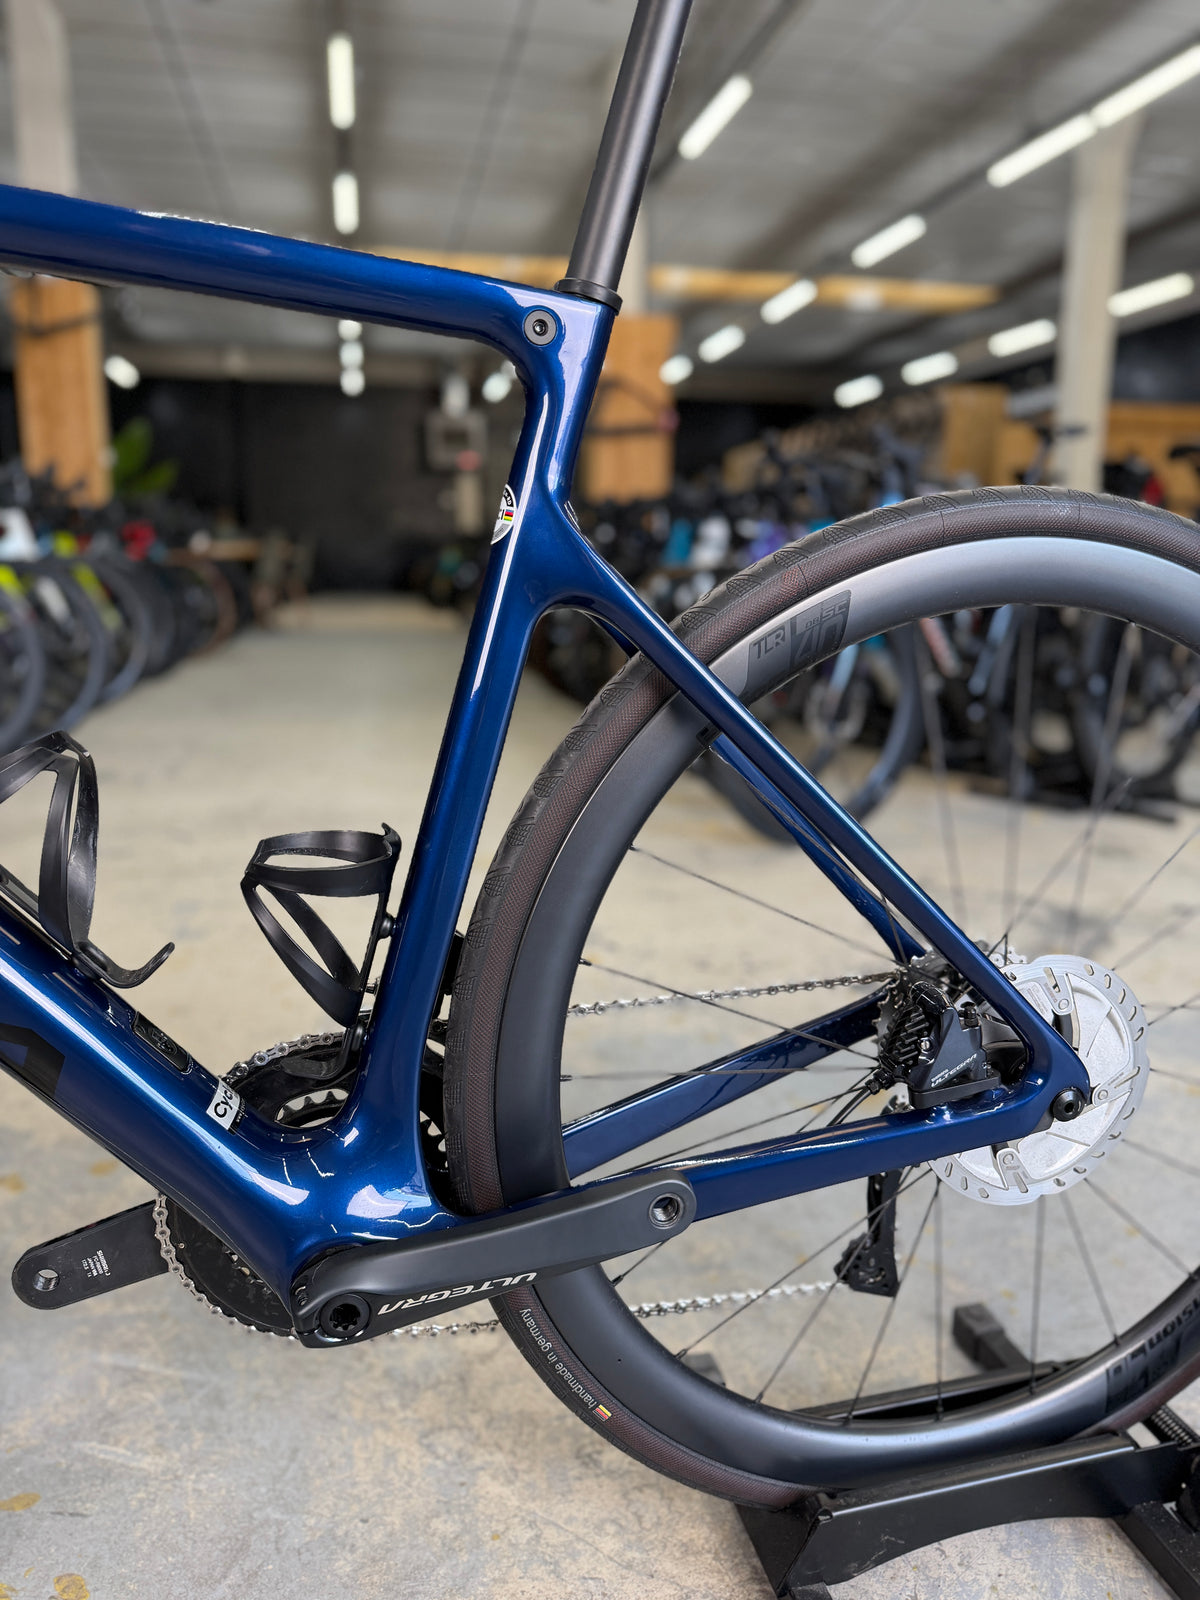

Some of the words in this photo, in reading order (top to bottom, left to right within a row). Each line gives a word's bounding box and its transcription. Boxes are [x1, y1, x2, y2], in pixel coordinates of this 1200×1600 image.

[753, 626, 786, 660] TLR
[930, 1053, 978, 1088] ULTEGRA
[377, 1272, 538, 1316] ULTEGRA
[519, 1308, 553, 1354] germany
[546, 1351, 559, 1364] in
[554, 1362, 598, 1409] handmade
